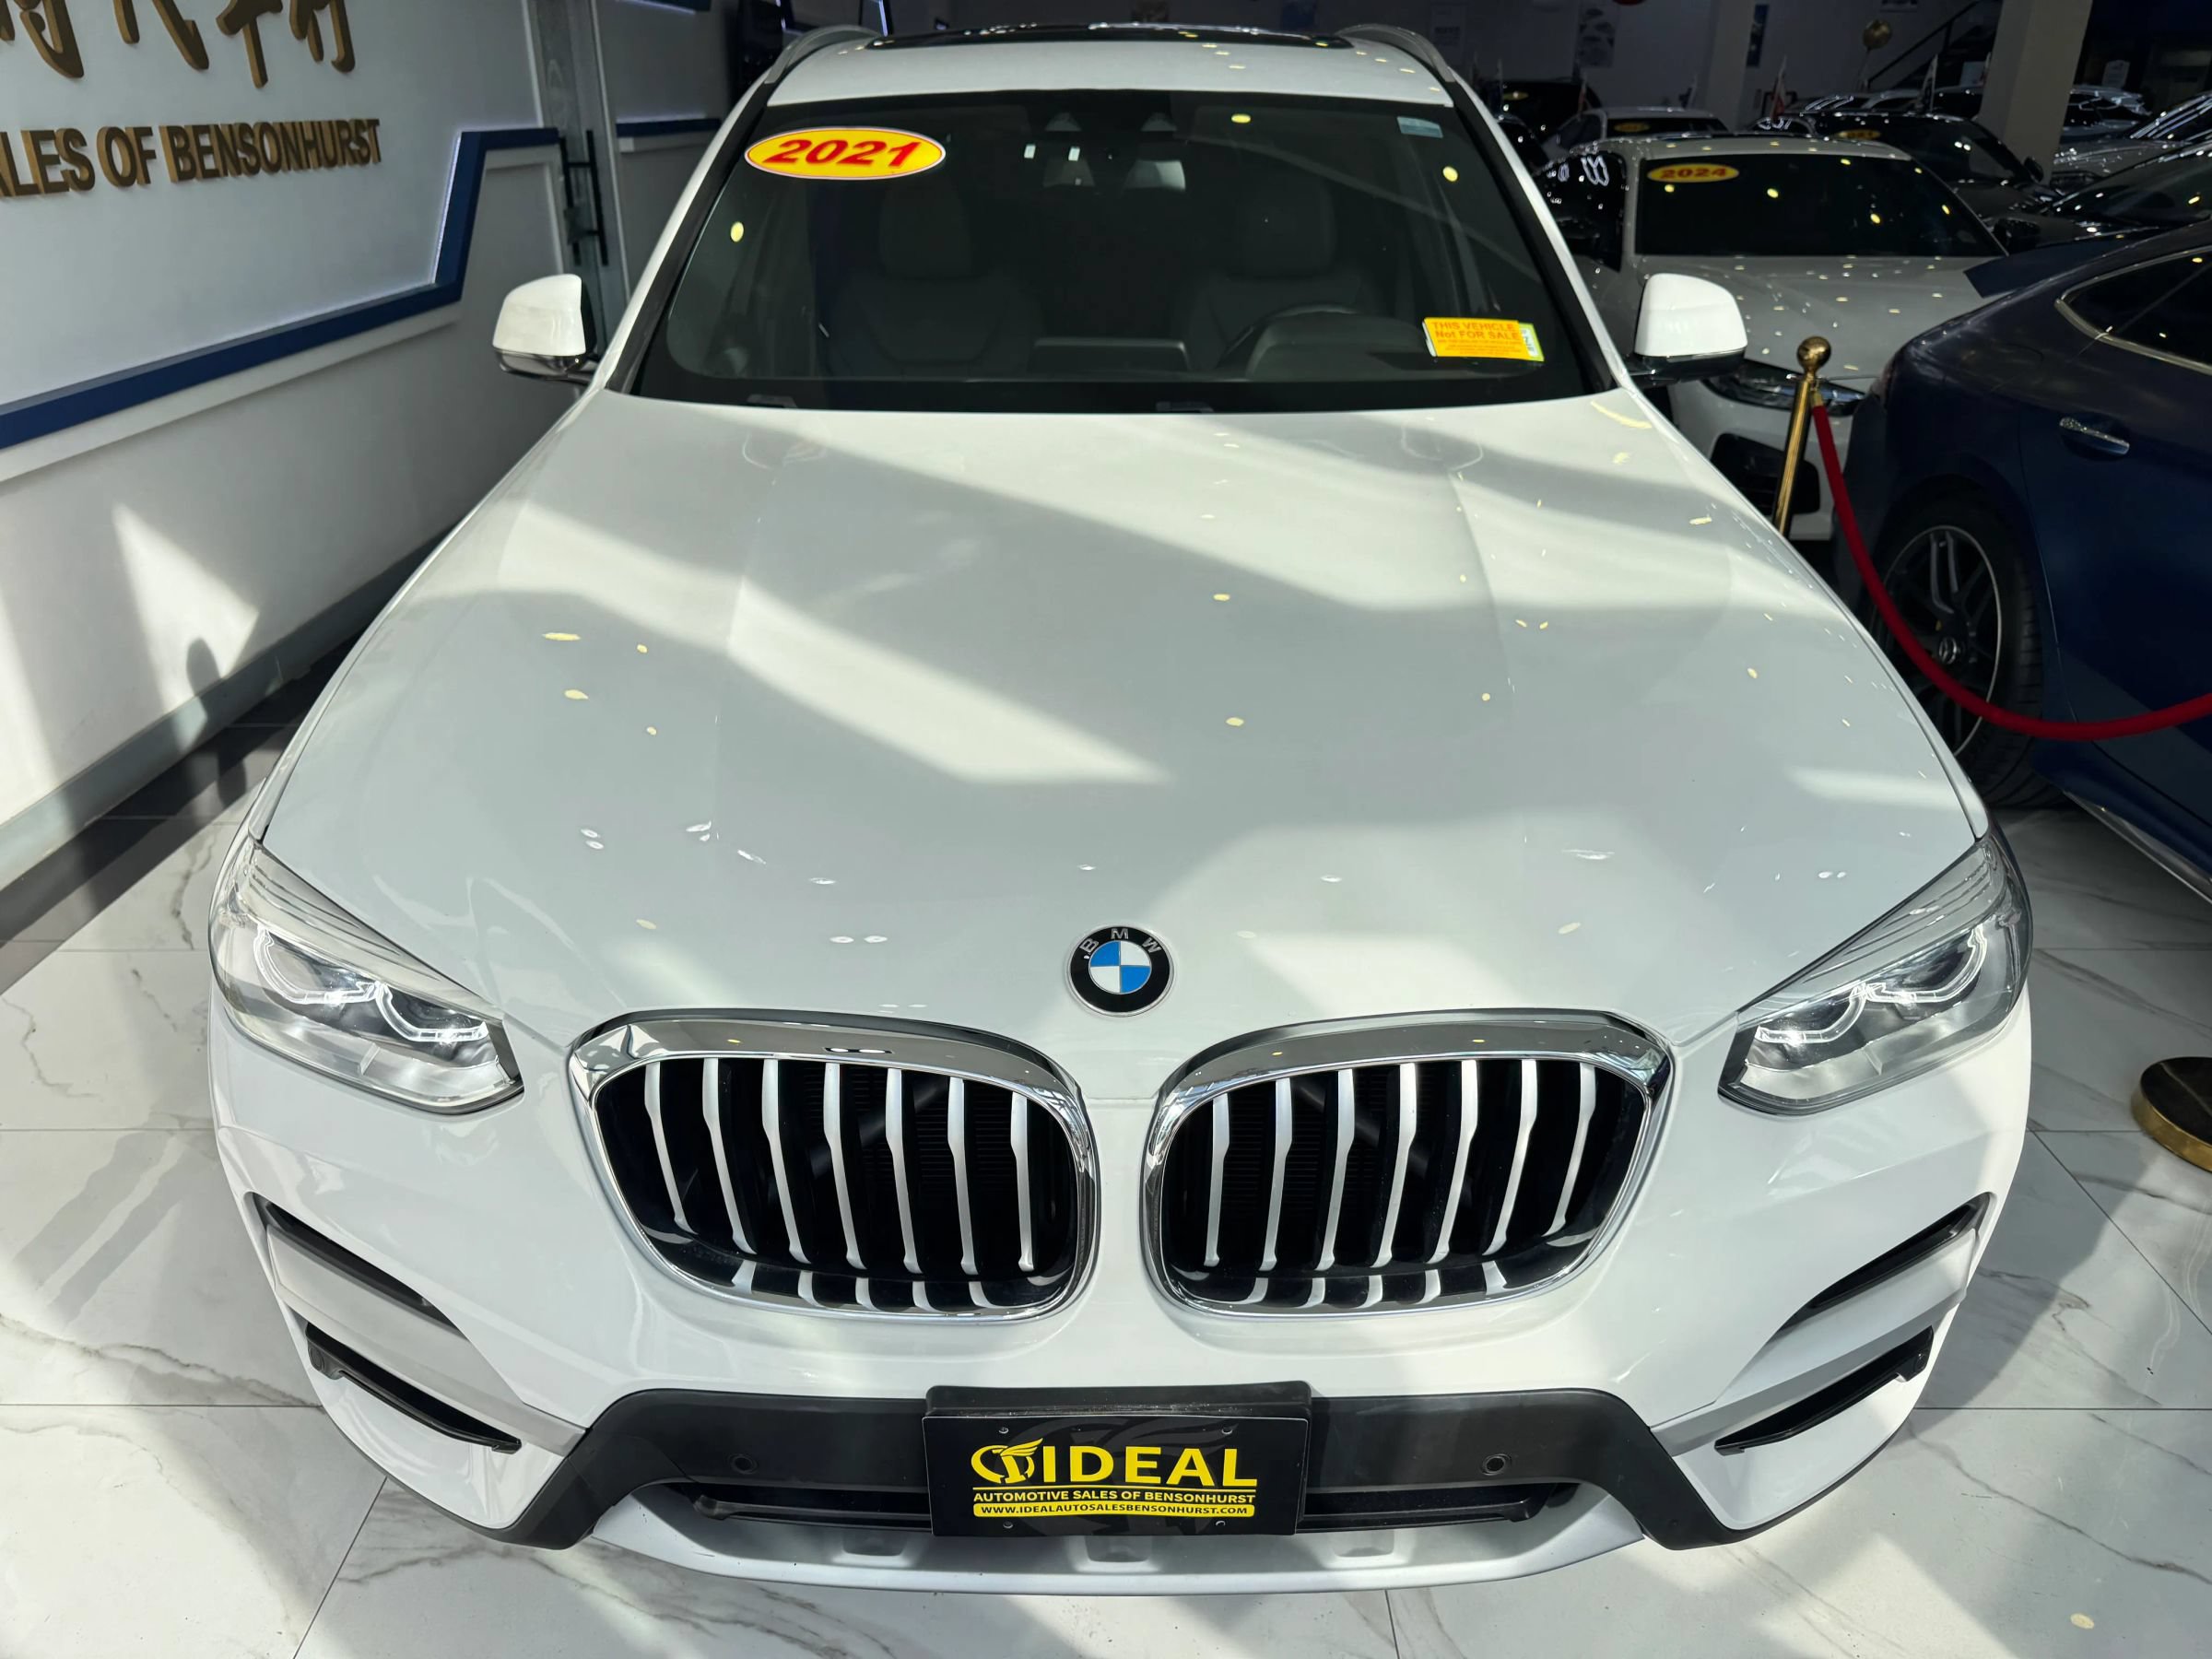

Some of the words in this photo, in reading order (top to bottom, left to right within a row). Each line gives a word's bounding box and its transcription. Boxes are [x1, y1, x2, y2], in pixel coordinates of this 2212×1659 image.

[0, 128, 95, 196] LES
[97, 126, 157, 187] OF
[159, 119, 381, 182] BENSONHURST
[762, 139, 921, 168] 2021
[1660, 168, 1726, 179] 2024
[1432, 322, 1460, 330] THIS
[1462, 323, 1514, 331] VEHICLE
[1079, 928, 1162, 954] BMW
[1042, 1445, 1257, 1487] IDEAL
[973, 1490, 1069, 1502] AUTOMOTIVE
[1073, 1490, 1118, 1500] SALES
[1121, 1491, 1141, 1500] OF
[1144, 1492, 1256, 1504] BENSONHURST
[981, 1503, 1248, 1514] WWW.IDEALAUTOSALESBENSONHURST.COM
